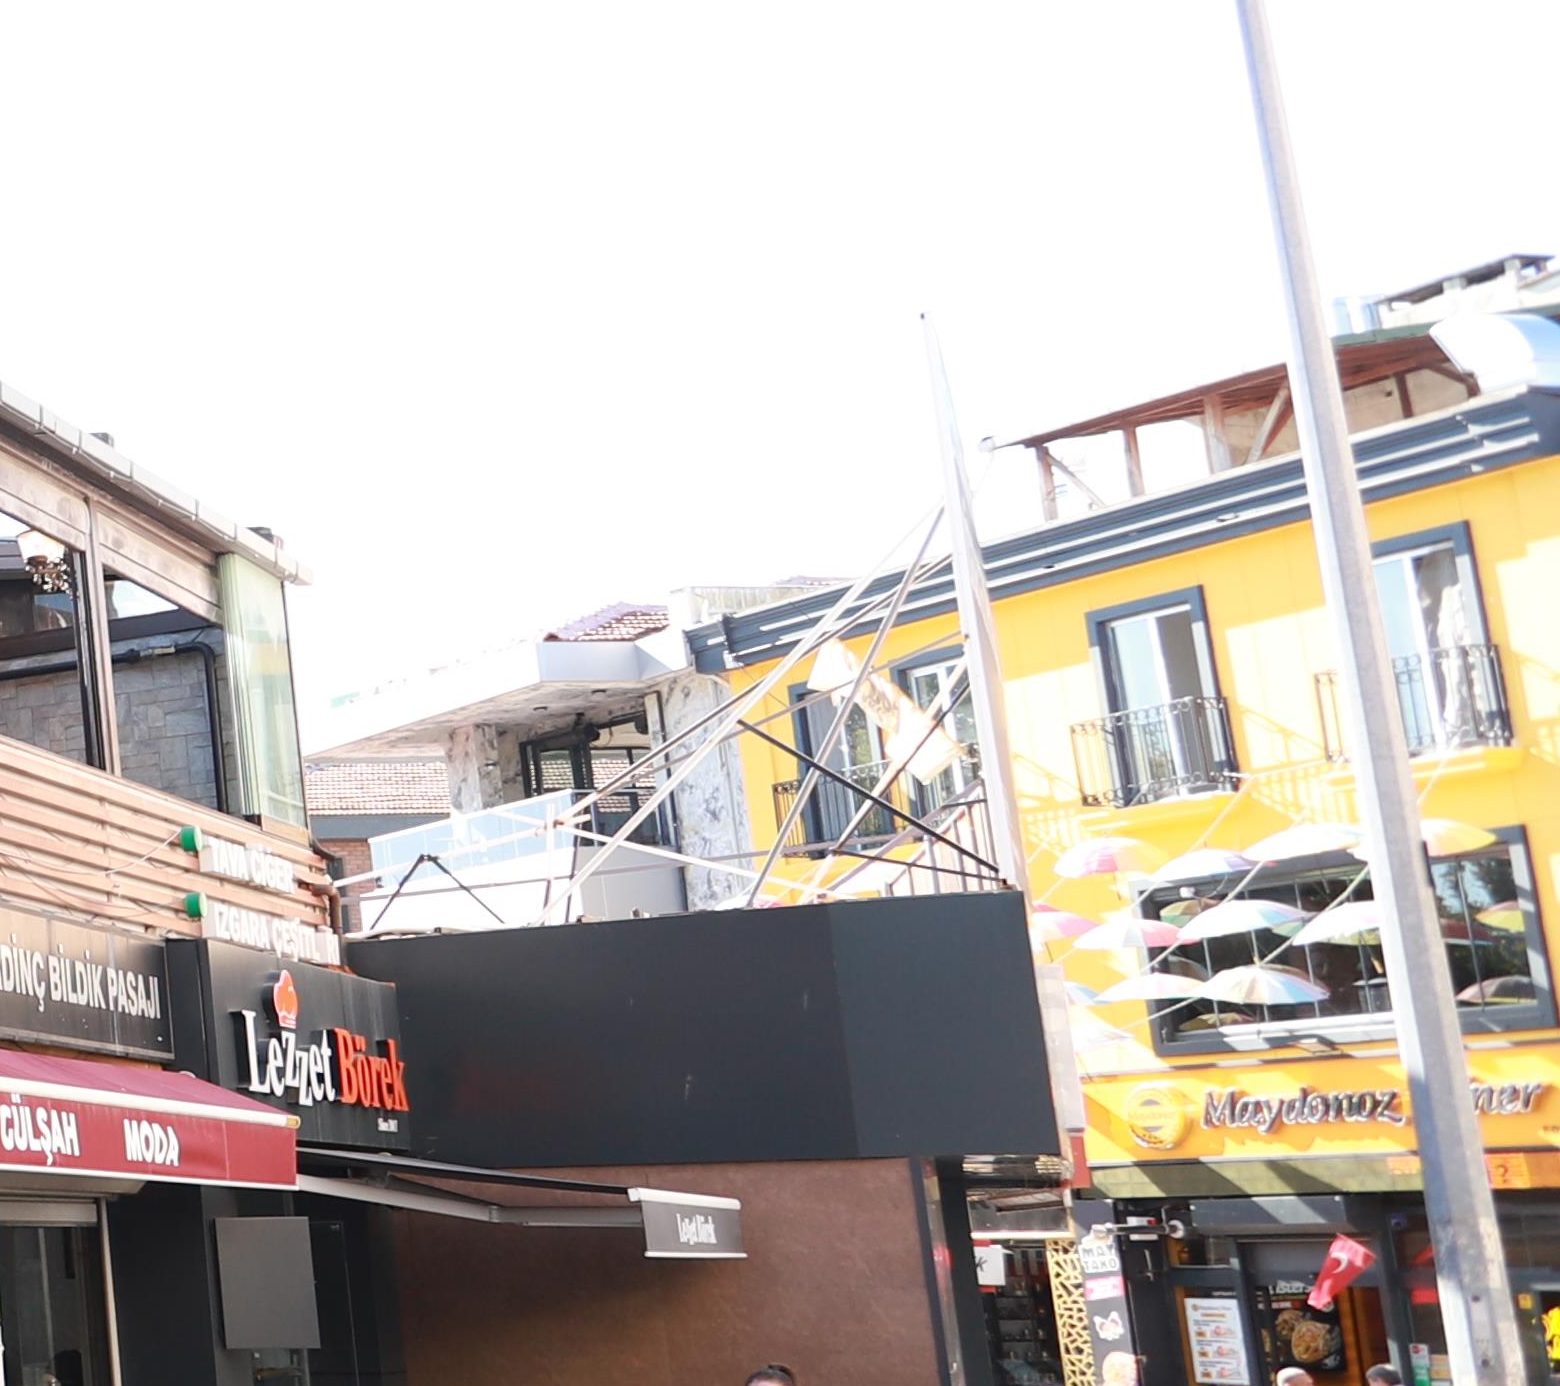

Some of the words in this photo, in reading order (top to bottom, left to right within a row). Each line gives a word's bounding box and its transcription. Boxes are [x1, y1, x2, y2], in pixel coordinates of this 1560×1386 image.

[202, 833, 249, 883] TAVA
[247, 844, 296, 895] CİĞER
[47, 943, 107, 1010] BİLDİK
[106, 967, 162, 1021] PASAJI
[235, 1009, 336, 1108] Lezzet
[333, 1027, 410, 1113] Börek
[1200, 1086, 1407, 1134] Maydonoz
[1469, 1076, 1544, 1115] ner
[122, 1119, 181, 1168] MODA
